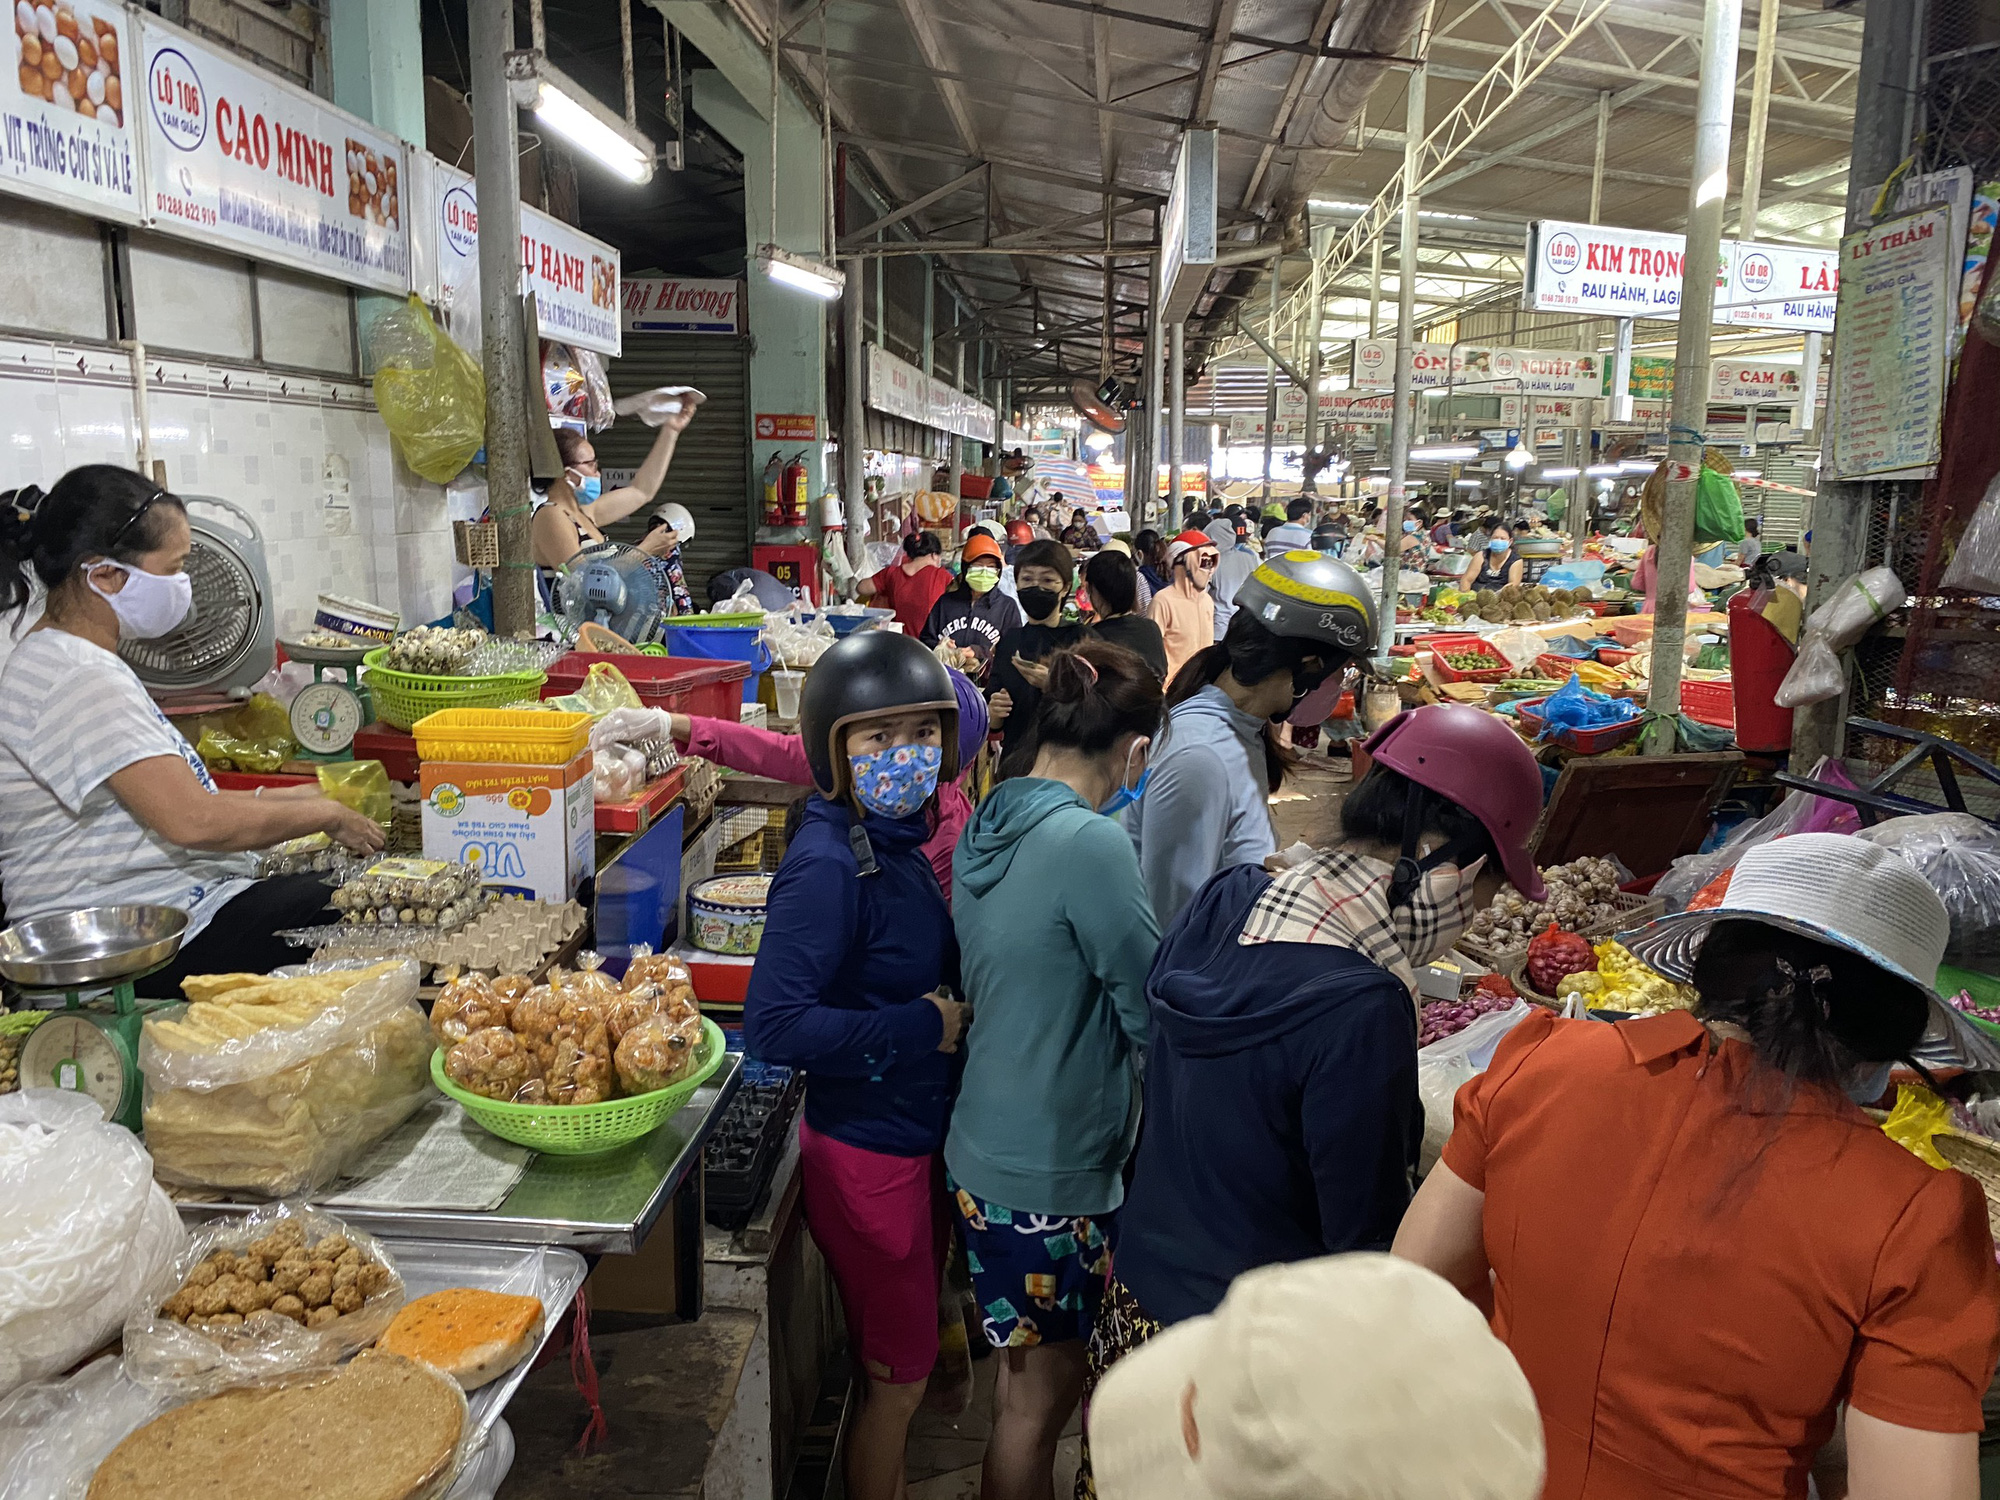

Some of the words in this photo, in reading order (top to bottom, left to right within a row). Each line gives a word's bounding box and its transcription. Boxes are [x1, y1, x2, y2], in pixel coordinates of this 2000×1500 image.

[157, 67, 173, 105] LÔ
[177, 80, 199, 116] 106
[163, 112, 179, 129] TAM
[27, 111, 66, 175] TRỨNG
[69, 124, 90, 182] CÚT
[103, 136, 120, 191] VÀ
[216, 96, 269, 170] CAO
[275, 122, 334, 197] MINH
[157, 192, 183, 217] 01288
[185, 202, 200, 222] 622
[201, 207, 216, 227] 919
[448, 200, 459, 227] LÔ
[462, 208, 478, 234] 105
[1551, 241, 1562, 257] LÔ
[1565, 245, 1576, 258] 09
[1586, 242, 1624, 273] KIM
[520, 234, 536, 275] U
[540, 243, 584, 294] HẠNH
[1745, 262, 1755, 276] LÔ
[1758, 265, 1768, 277] 08
[653, 281, 736, 319] Hương
[1582, 283, 1607, 299] RAU
[1610, 282, 1649, 305] HÀNH,
[1784, 303, 1804, 317] RAU
[1520, 357, 1571, 378] NGUYỆT
[1740, 370, 1775, 383] CAM
[777, 566, 791, 580] 05
